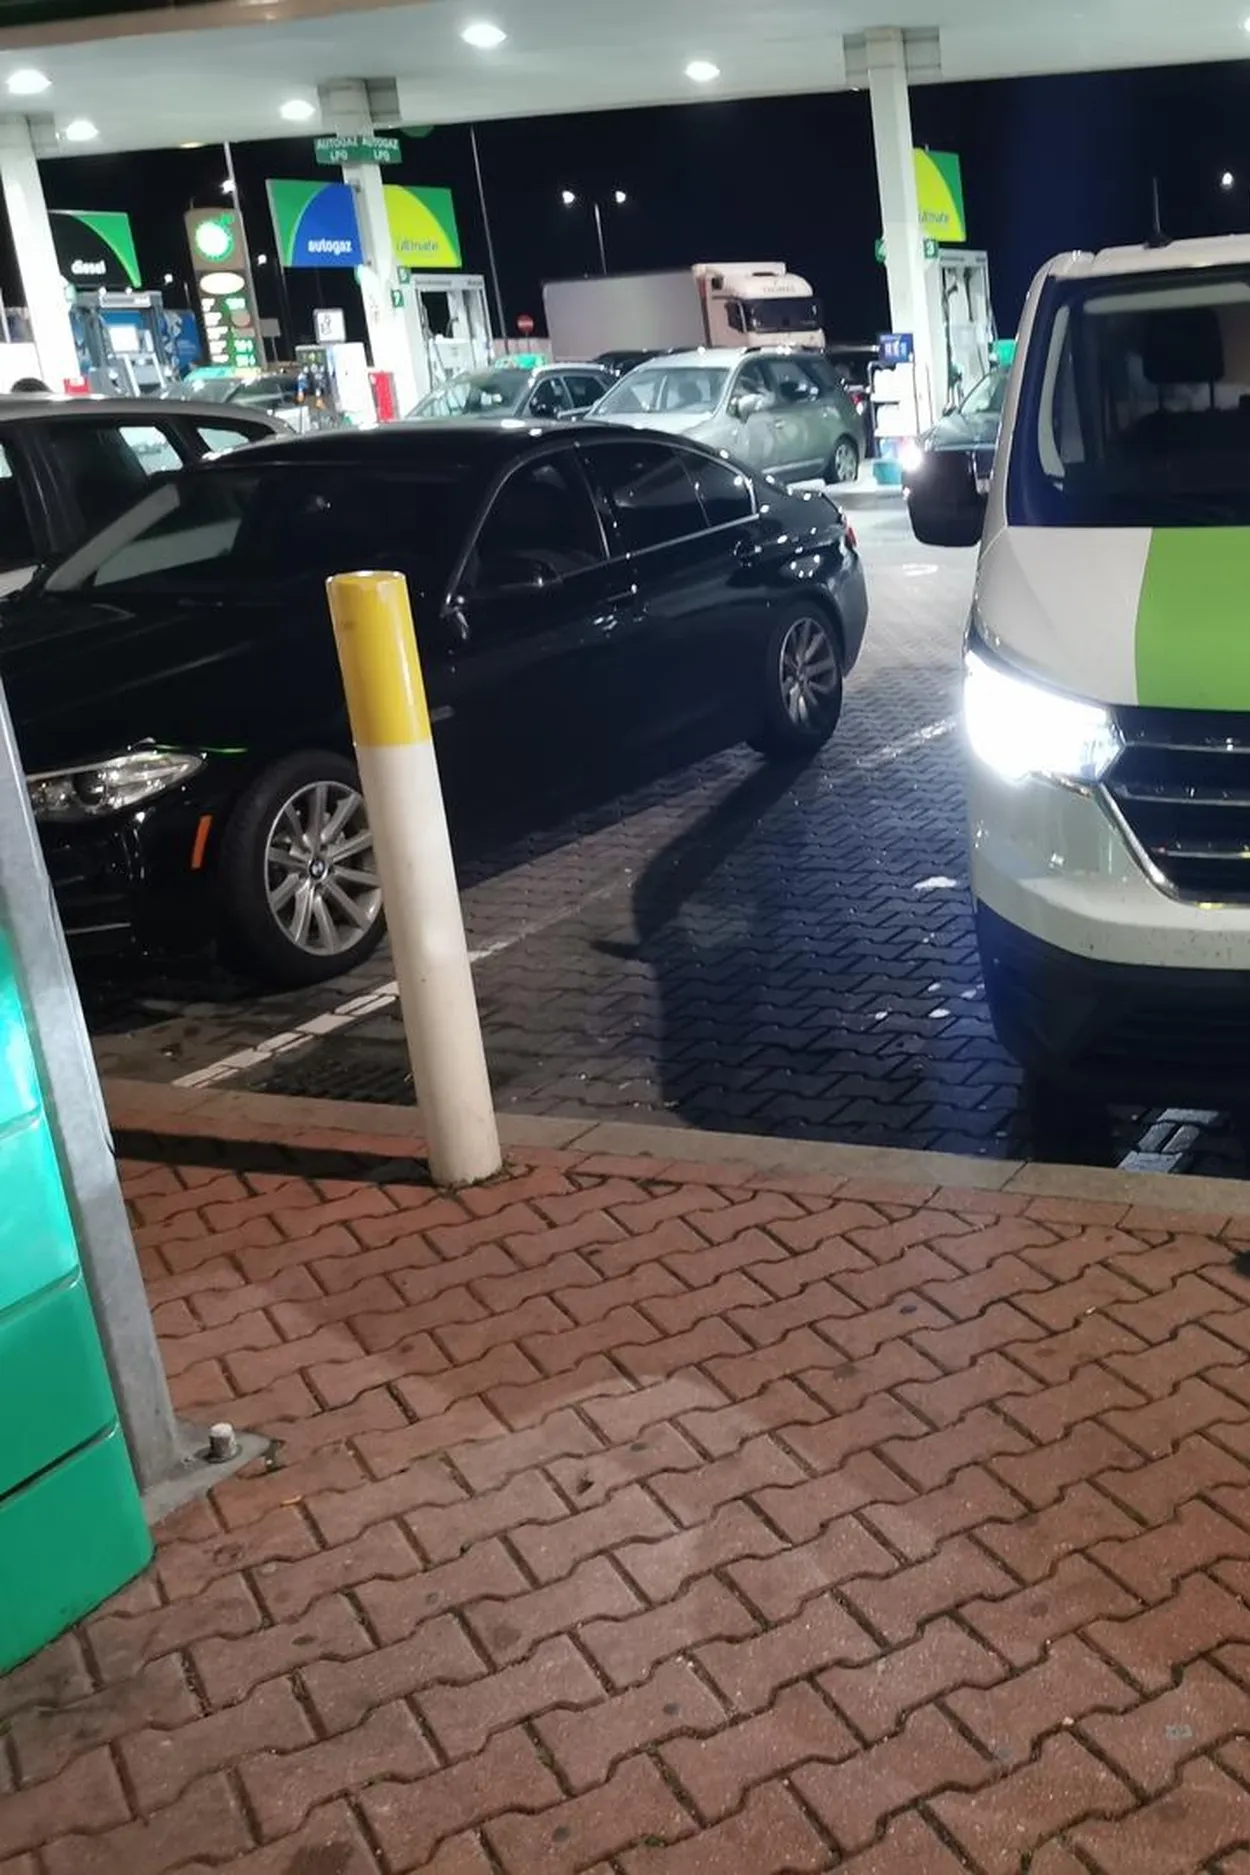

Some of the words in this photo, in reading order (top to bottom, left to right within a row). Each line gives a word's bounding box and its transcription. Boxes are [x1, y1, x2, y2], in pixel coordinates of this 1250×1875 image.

[316, 136, 358, 150] AUTOGAZ
[308, 239, 353, 256] autogaz
[71, 259, 107, 275] diesel
